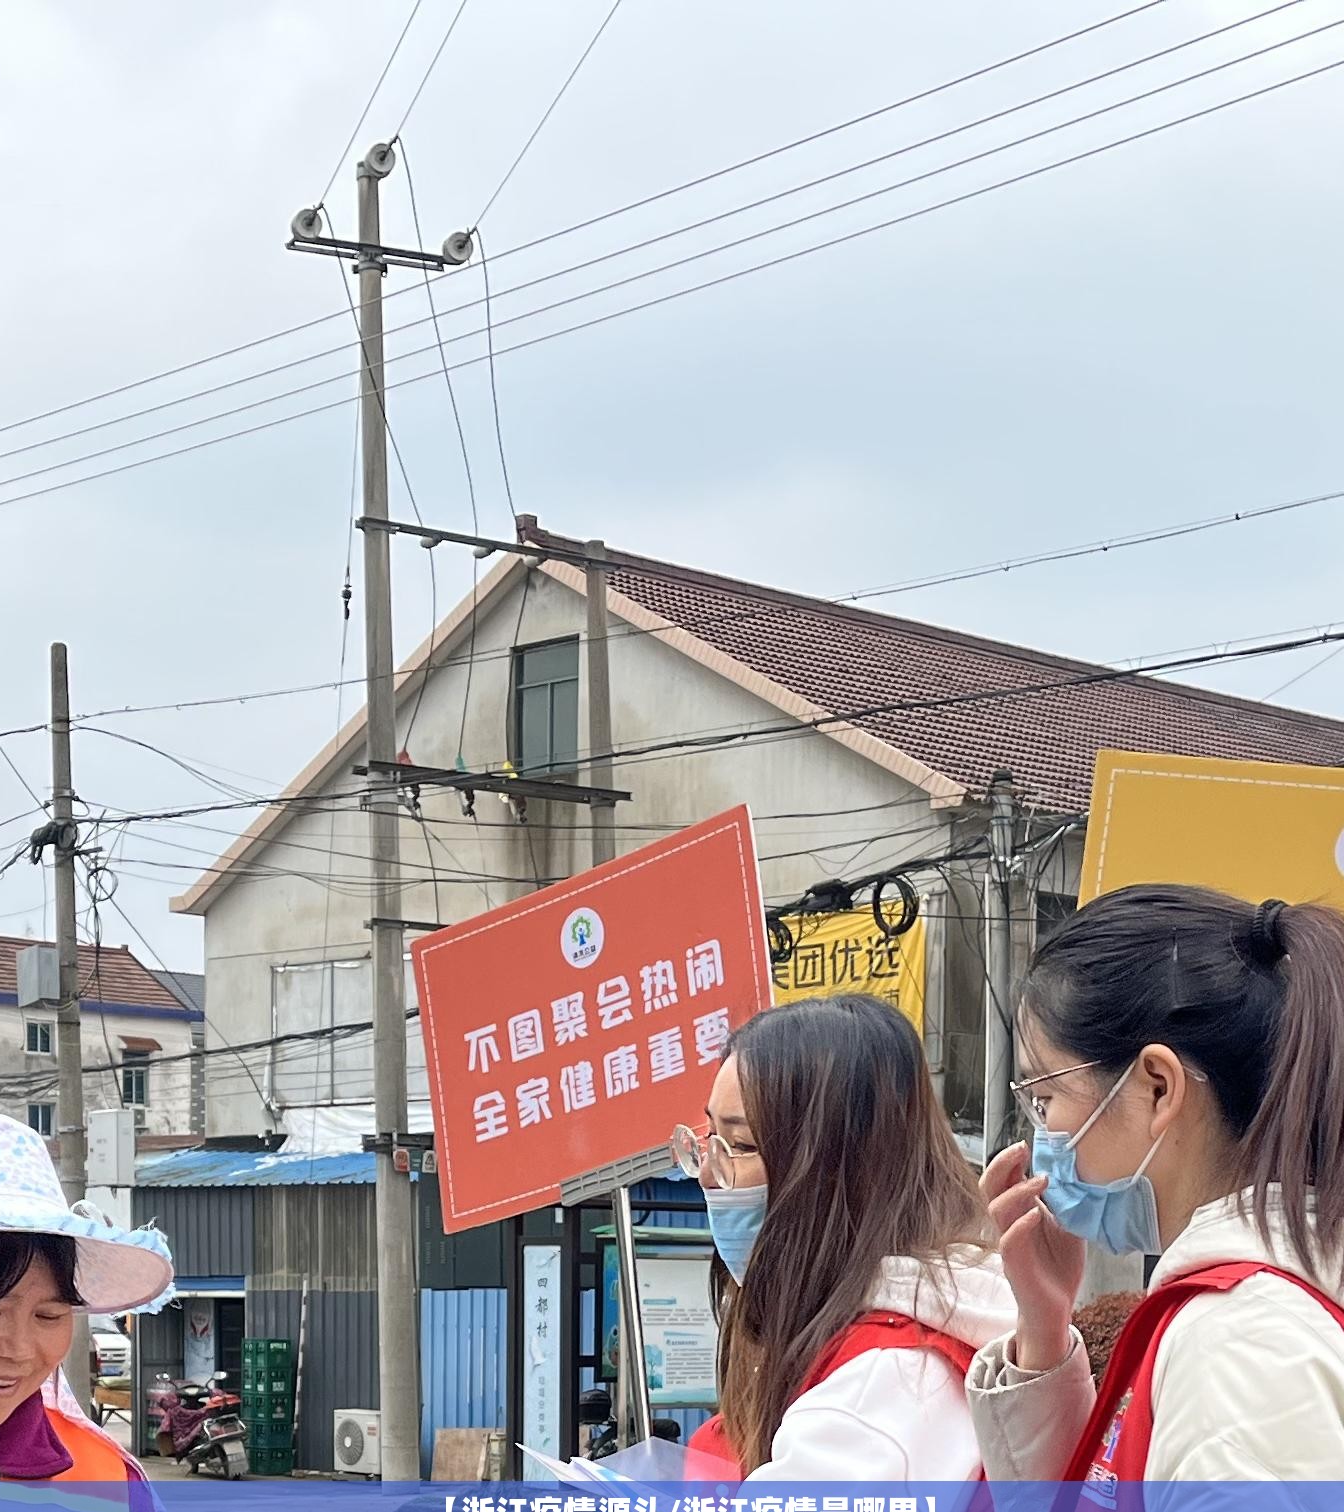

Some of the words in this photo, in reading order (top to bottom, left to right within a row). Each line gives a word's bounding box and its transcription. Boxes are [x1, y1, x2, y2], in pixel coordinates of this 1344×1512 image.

[464, 938, 725, 1073] 不图聚会热闹
[472, 1007, 730, 1143] 全家健康重要
